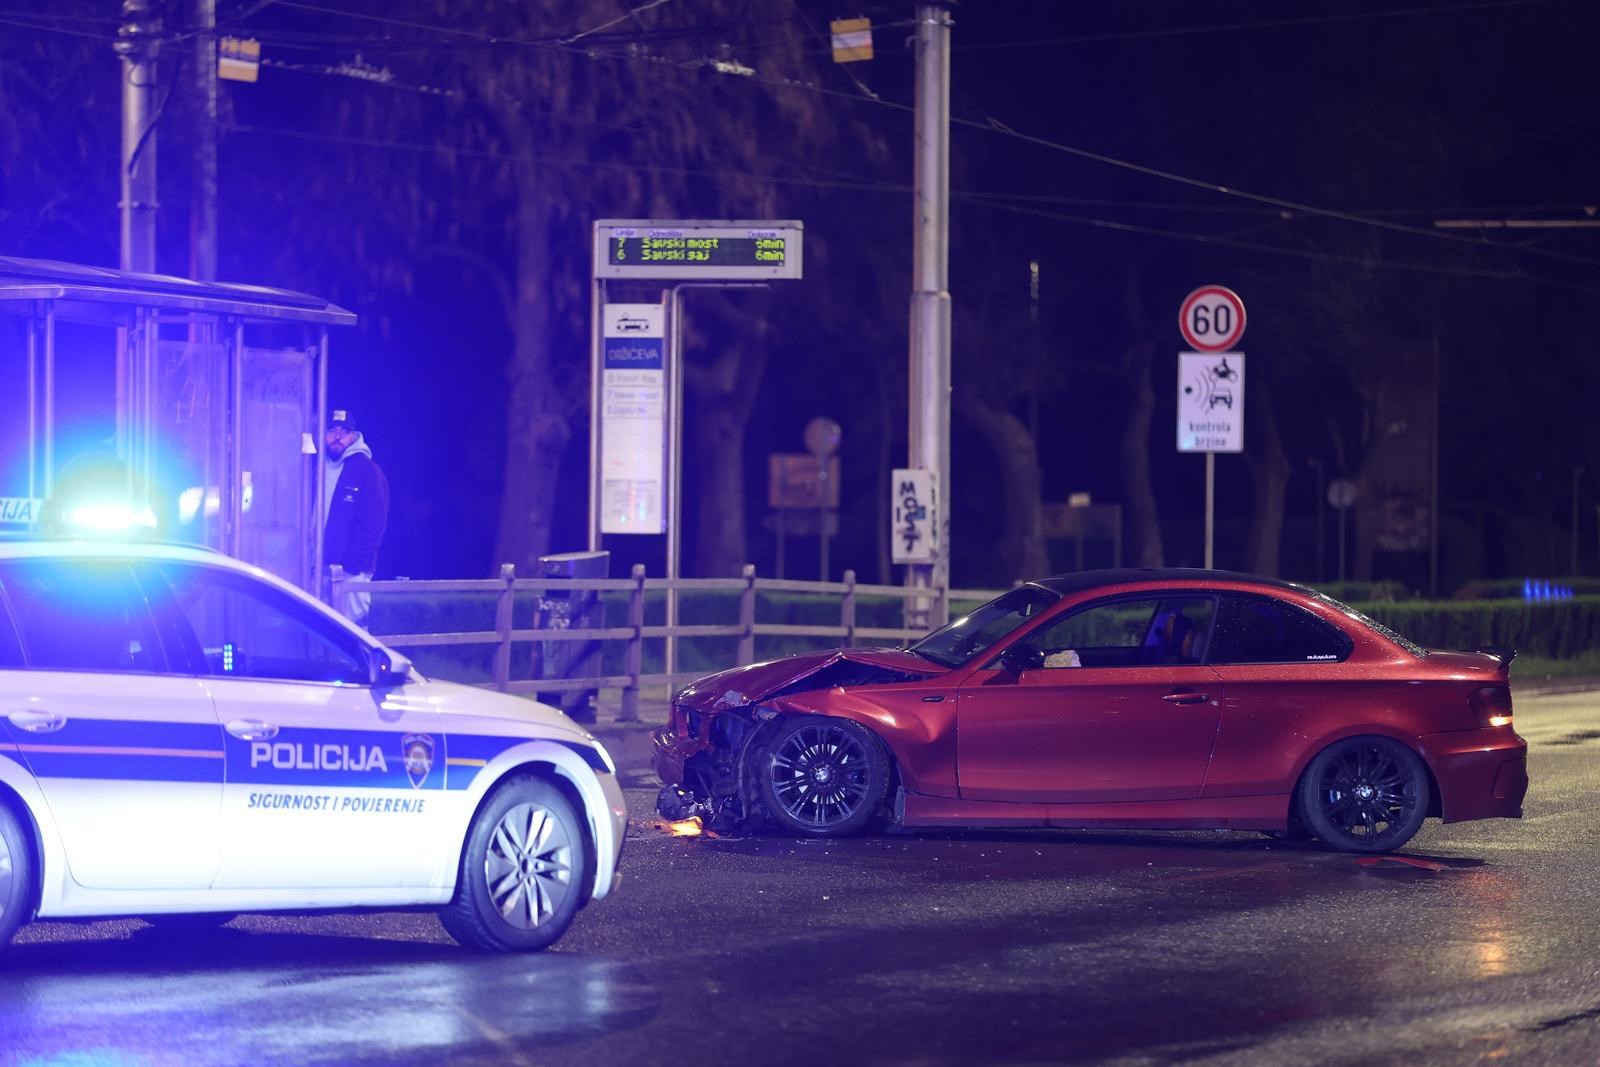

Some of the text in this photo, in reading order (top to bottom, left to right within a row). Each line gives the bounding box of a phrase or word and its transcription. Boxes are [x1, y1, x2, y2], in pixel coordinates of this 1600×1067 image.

[617, 238, 626, 248] 7
[641, 238, 686, 249] Savski
[687, 239, 719, 249] most
[617, 250, 626, 260] 6
[641, 250, 686, 261] Savski
[755, 250, 785, 261] 6min
[1193, 304, 1231, 335] 60
[1189, 420, 1232, 433] kontrola
[1195, 436, 1227, 447] brzine
[0, 501, 32, 520] IJA
[250, 742, 388, 773] POLICIJA
[248, 793, 426, 813] SIGURNOST I POVJERENJE
